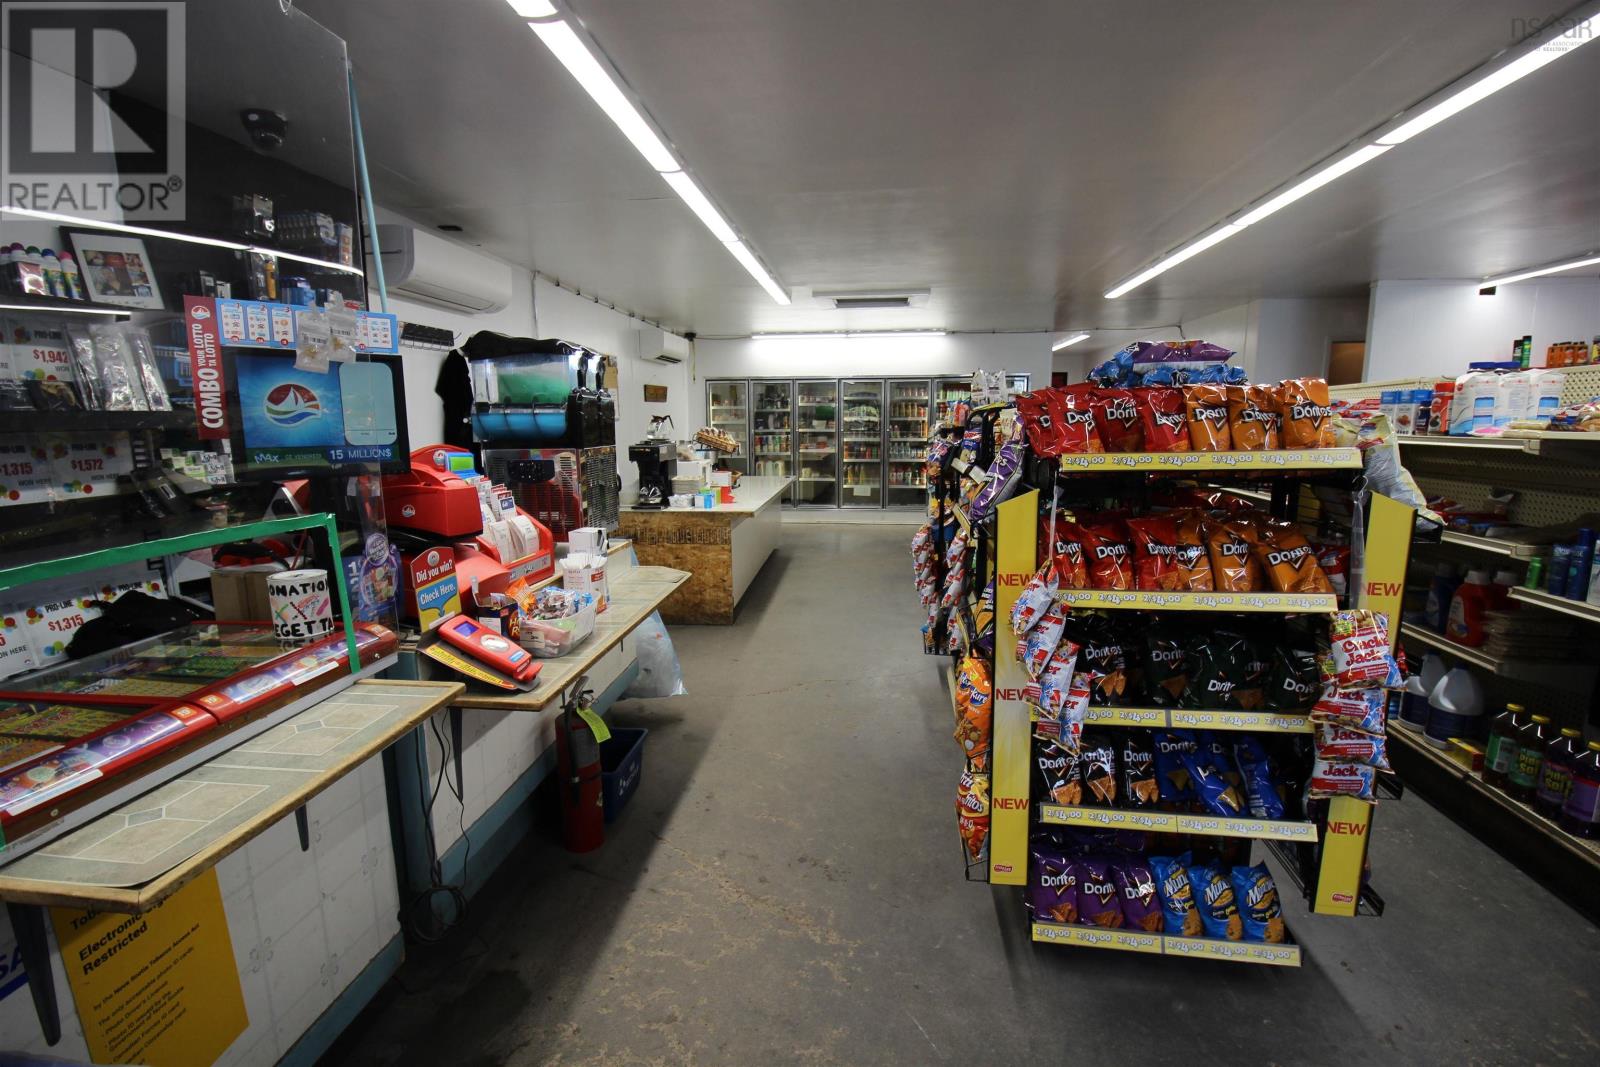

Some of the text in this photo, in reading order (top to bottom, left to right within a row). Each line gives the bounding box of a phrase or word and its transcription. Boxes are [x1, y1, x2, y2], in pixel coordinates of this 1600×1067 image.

[204, 333, 215, 358] LOTTO
[33, 349, 69, 364] $1,942
[192, 323, 224, 429] COMBO YOUR LOTTO
[330, 450, 344, 461] 15
[416, 558, 453, 583] Did you win?
[420, 587, 441, 605] Check
[45, 600, 74, 613] PRO-LINE
[10, 645, 27, 656] HERE
[1323, 761, 1359, 777] Jack
[994, 798, 1029, 810] NEW
[1328, 821, 1367, 836] NEW
[78, 912, 142, 962] Electronic
[83, 921, 148, 976] Restricted
